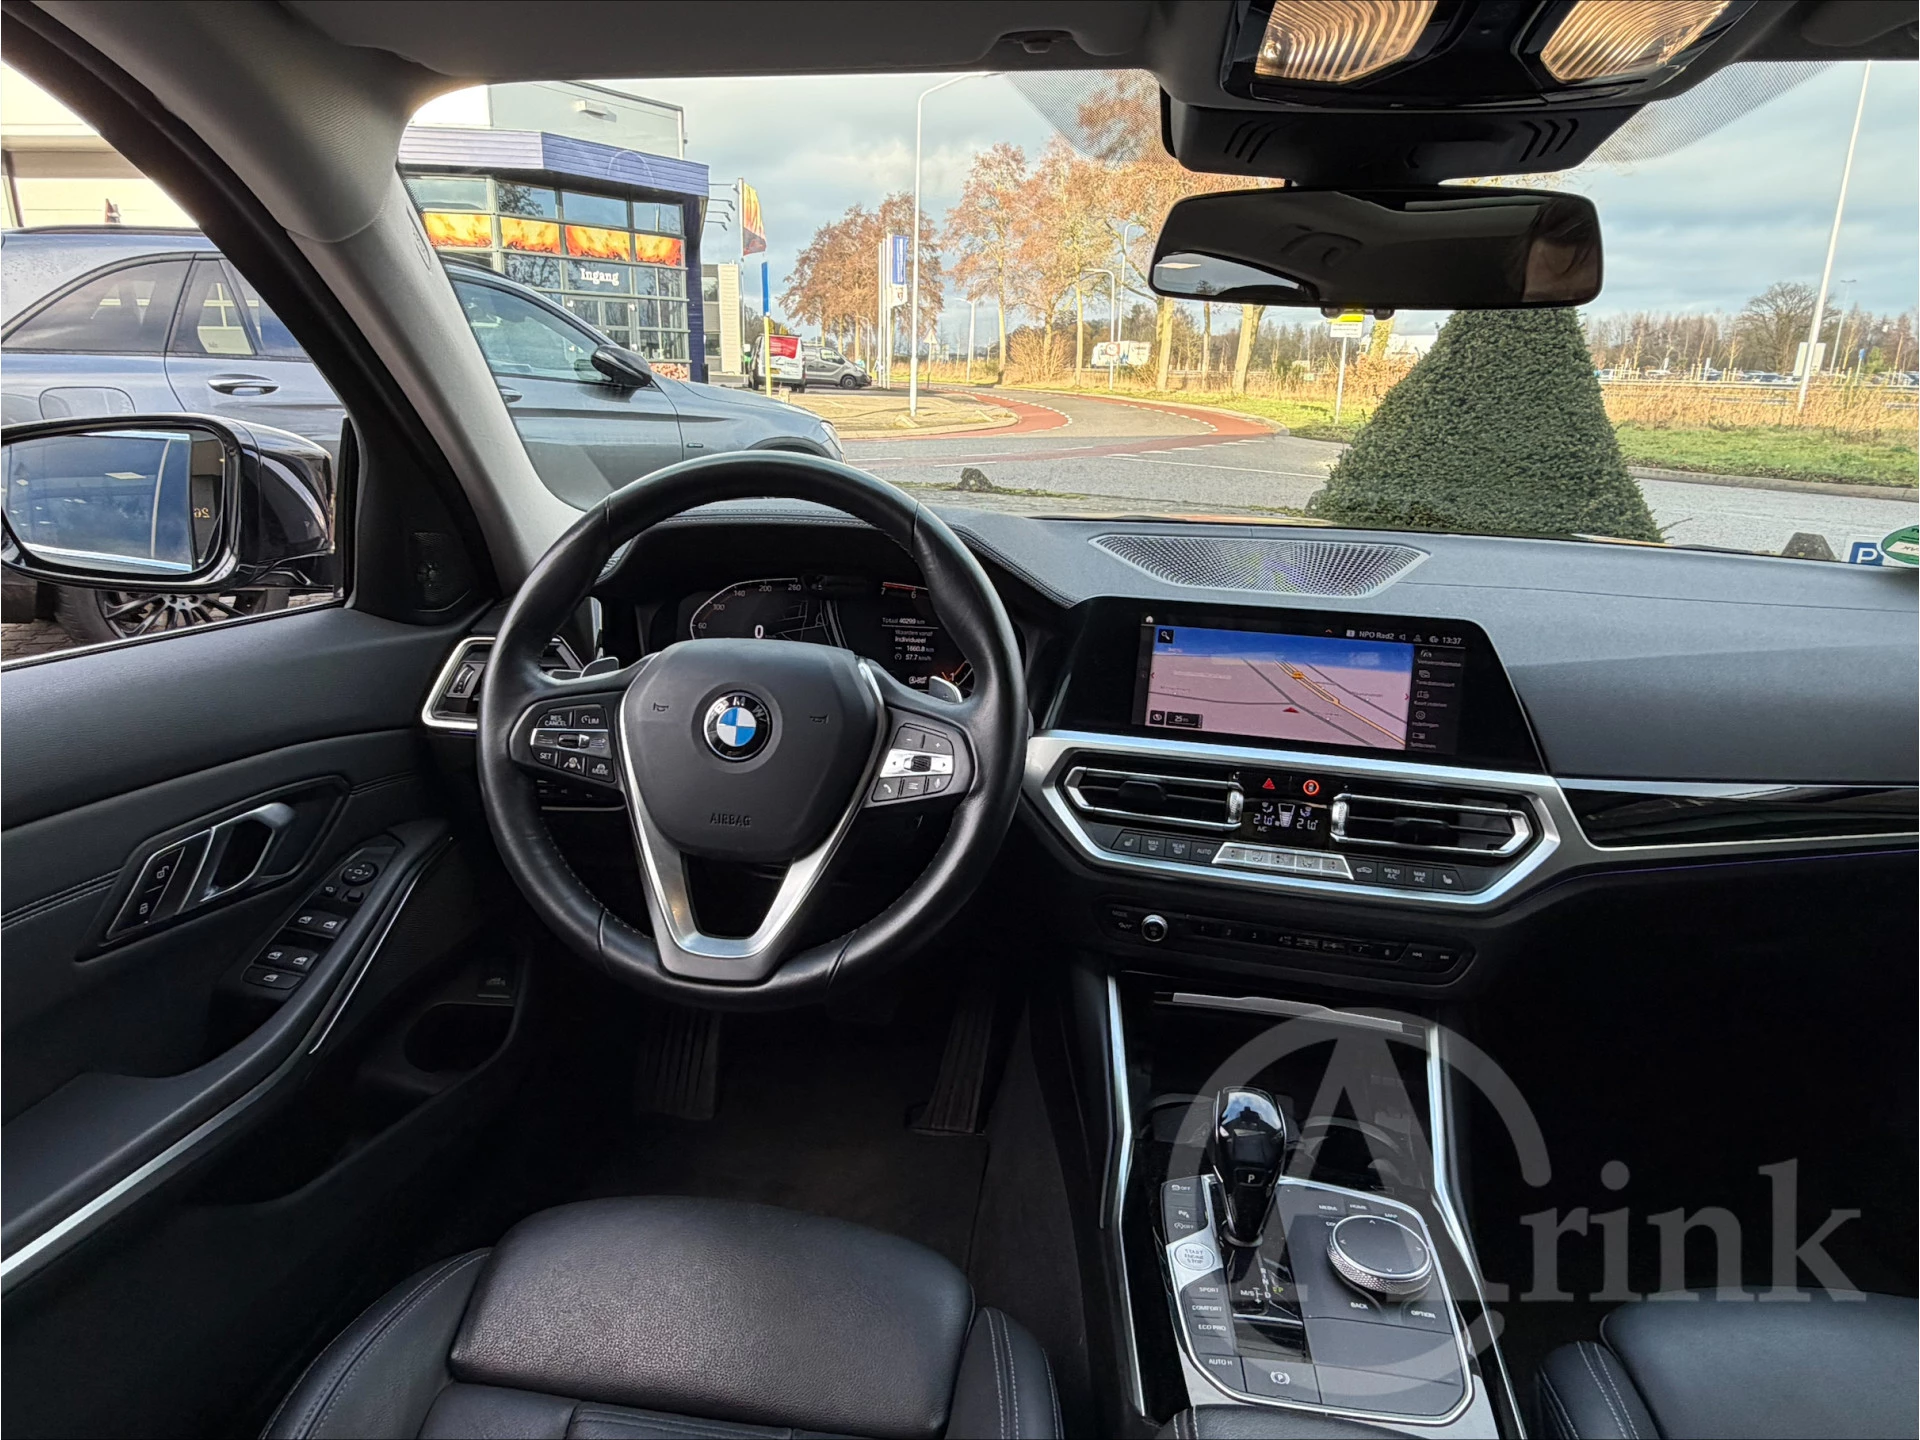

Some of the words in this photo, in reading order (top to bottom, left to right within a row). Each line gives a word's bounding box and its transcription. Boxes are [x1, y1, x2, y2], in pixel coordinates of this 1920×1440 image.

[580, 267, 620, 286] Ingang
[1856, 547, 1878, 563] P
[788, 583, 801, 591] 260
[911, 591, 917, 599] 6
[754, 625, 764, 639] 0
[1359, 631, 1375, 639] NPO
[1442, 637, 1462, 645] 13:37
[540, 752, 552, 760] SET
[592, 767, 608, 776] MODE
[710, 812, 751, 827] AIRBAG
[1247, 1174, 1255, 1183] P
[1192, 1304, 1222, 1312] COMFORT
[1350, 1301, 1368, 1310] BACK
[1411, 1310, 1436, 1319] OPTION
